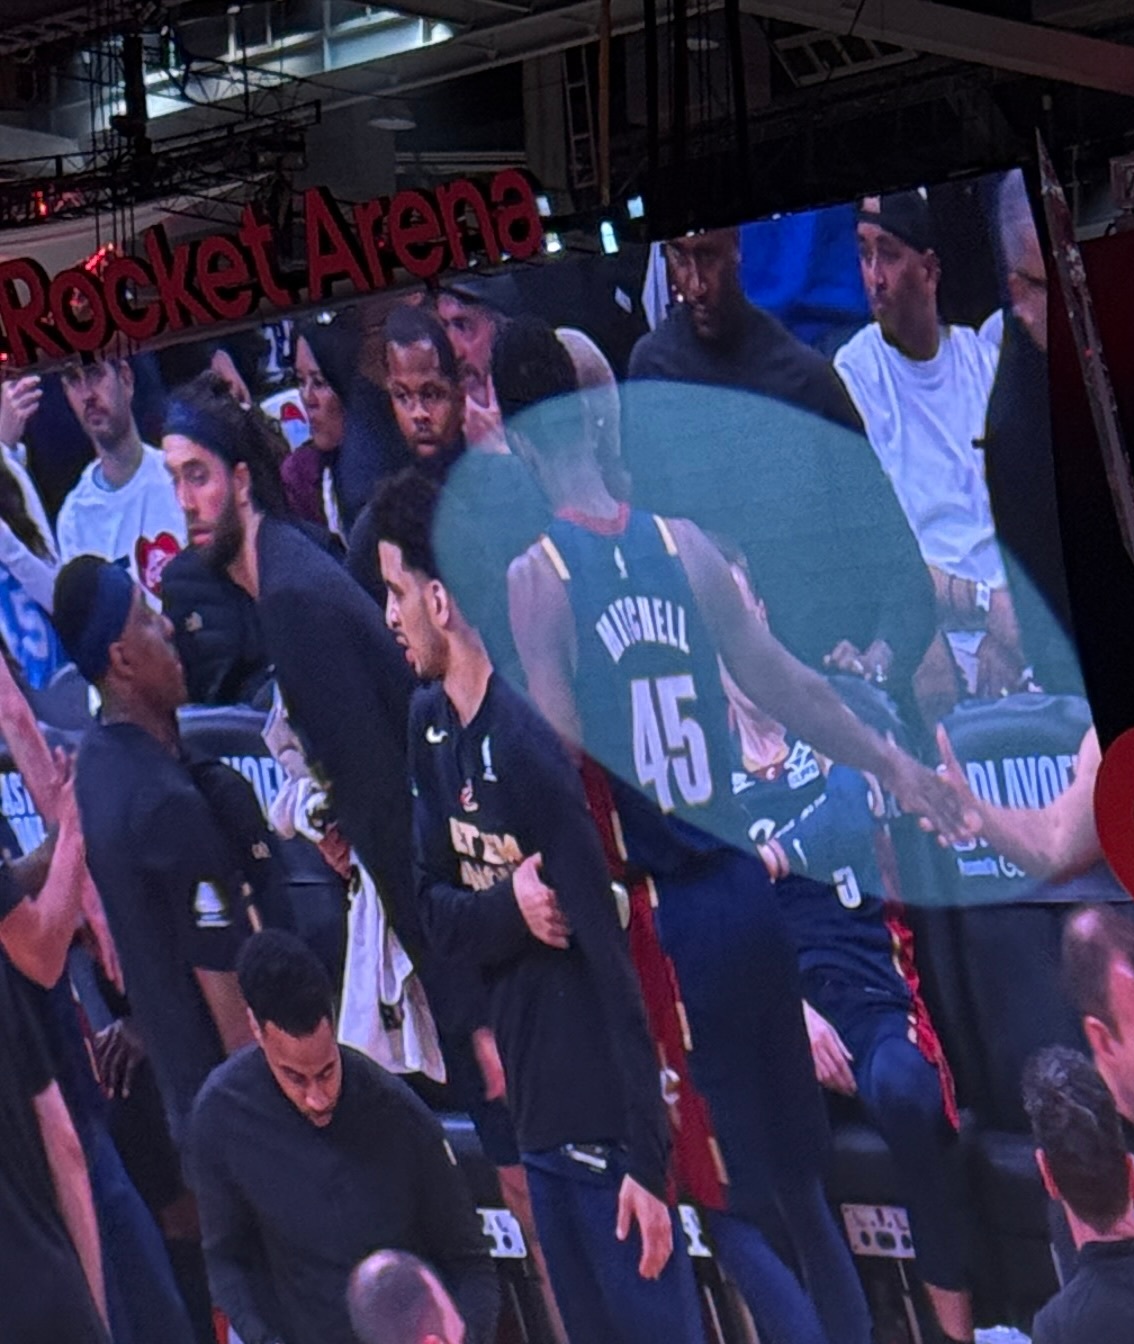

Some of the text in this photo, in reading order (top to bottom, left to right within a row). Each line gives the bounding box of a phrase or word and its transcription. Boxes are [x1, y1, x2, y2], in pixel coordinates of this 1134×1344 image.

[0, 168, 544, 364] Rocket Arena
[595, 596, 690, 664] MITCHELL
[631, 673, 713, 814] 45
